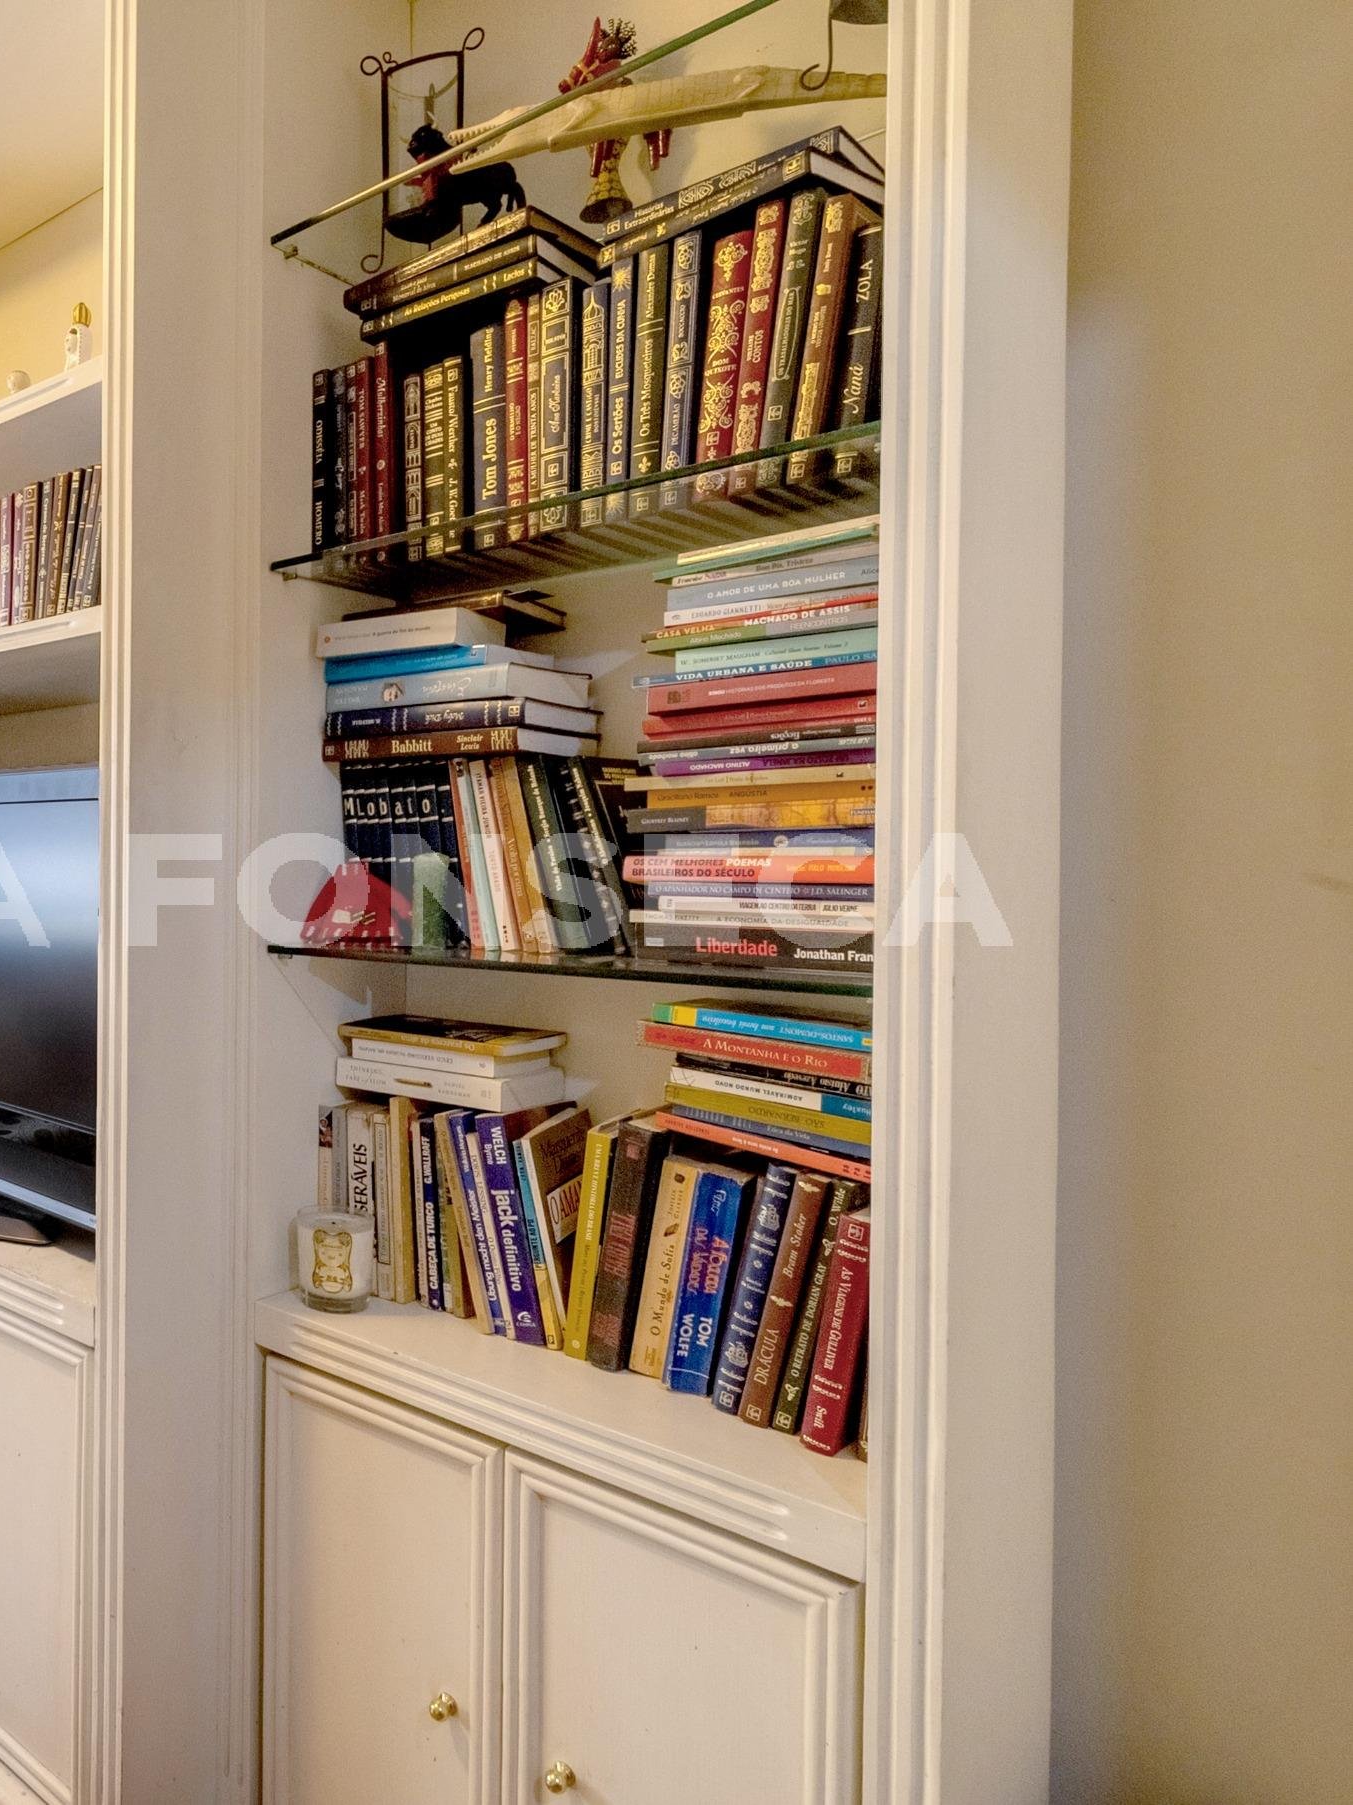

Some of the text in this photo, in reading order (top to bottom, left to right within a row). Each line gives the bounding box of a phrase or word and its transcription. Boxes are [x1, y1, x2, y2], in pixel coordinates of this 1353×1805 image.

[856, 259, 874, 303] ZOLA
[616, 299, 626, 330] CUNHA
[753, 329, 764, 363] CONTOS
[615, 345, 625, 379] EUCLIDES
[484, 365, 495, 393] Henry
[640, 339, 655, 437] Os Três Mosqueteiros
[611, 397, 623, 455] Os Sertões
[482, 418, 498, 500] Tom Jones
[314, 501, 324, 546] HOMERO
[716, 588, 741, 598] AMOR
[744, 585, 755, 593] DE
[758, 583, 779, 592] UMA
[782, 579, 801, 588] BOA
[805, 572, 846, 583] MULHER
[744, 612, 798, 627] MACHADO
[801, 610, 816, 619] DE
[819, 605, 851, 616] ASSIS
[656, 625, 715, 639] CASA VELHA
[676, 672, 703, 681] VIDA
[707, 665, 754, 677] URBANA
[770, 659, 813, 671] SAÚDE
[424, 709, 464, 725] Moby Dick
[391, 739, 433, 754] Babbitt
[457, 734, 483, 744] Sinclair
[460, 741, 480, 750] Lewis
[696, 868, 712, 877] DO
[715, 867, 755, 877] SÉCULO
[726, 858, 772, 867] POEMAS
[826, 888, 869, 897] SALINGER
[696, 936, 778, 957] Liberdade
[793, 948, 845, 961] Jonathan
[703, 1038, 712, 1049] A
[714, 1079, 803, 1102] ADMIRÁVEL MUNDO NOVO
[490, 1126, 507, 1165] WELCH
[831, 1187, 846, 1213] Wilde
[425, 1202, 436, 1240] TURCO
[490, 1189, 523, 1292] jack definitivo
[782, 1213, 808, 1278] Bram Stoker
[427, 1250, 439, 1290] CABEÇA
[813, 1261, 827, 1285] GRAY
[649, 1243, 675, 1336] O Mundo de Sofia
[805, 1286, 822, 1318] DORIAN
[677, 1313, 695, 1357] WOLFE
[696, 1316, 713, 1347] TOM
[753, 1328, 780, 1385] DRÁCULA
[792, 1332, 810, 1369] RETRATO
[812, 1405, 827, 1429] Swift
